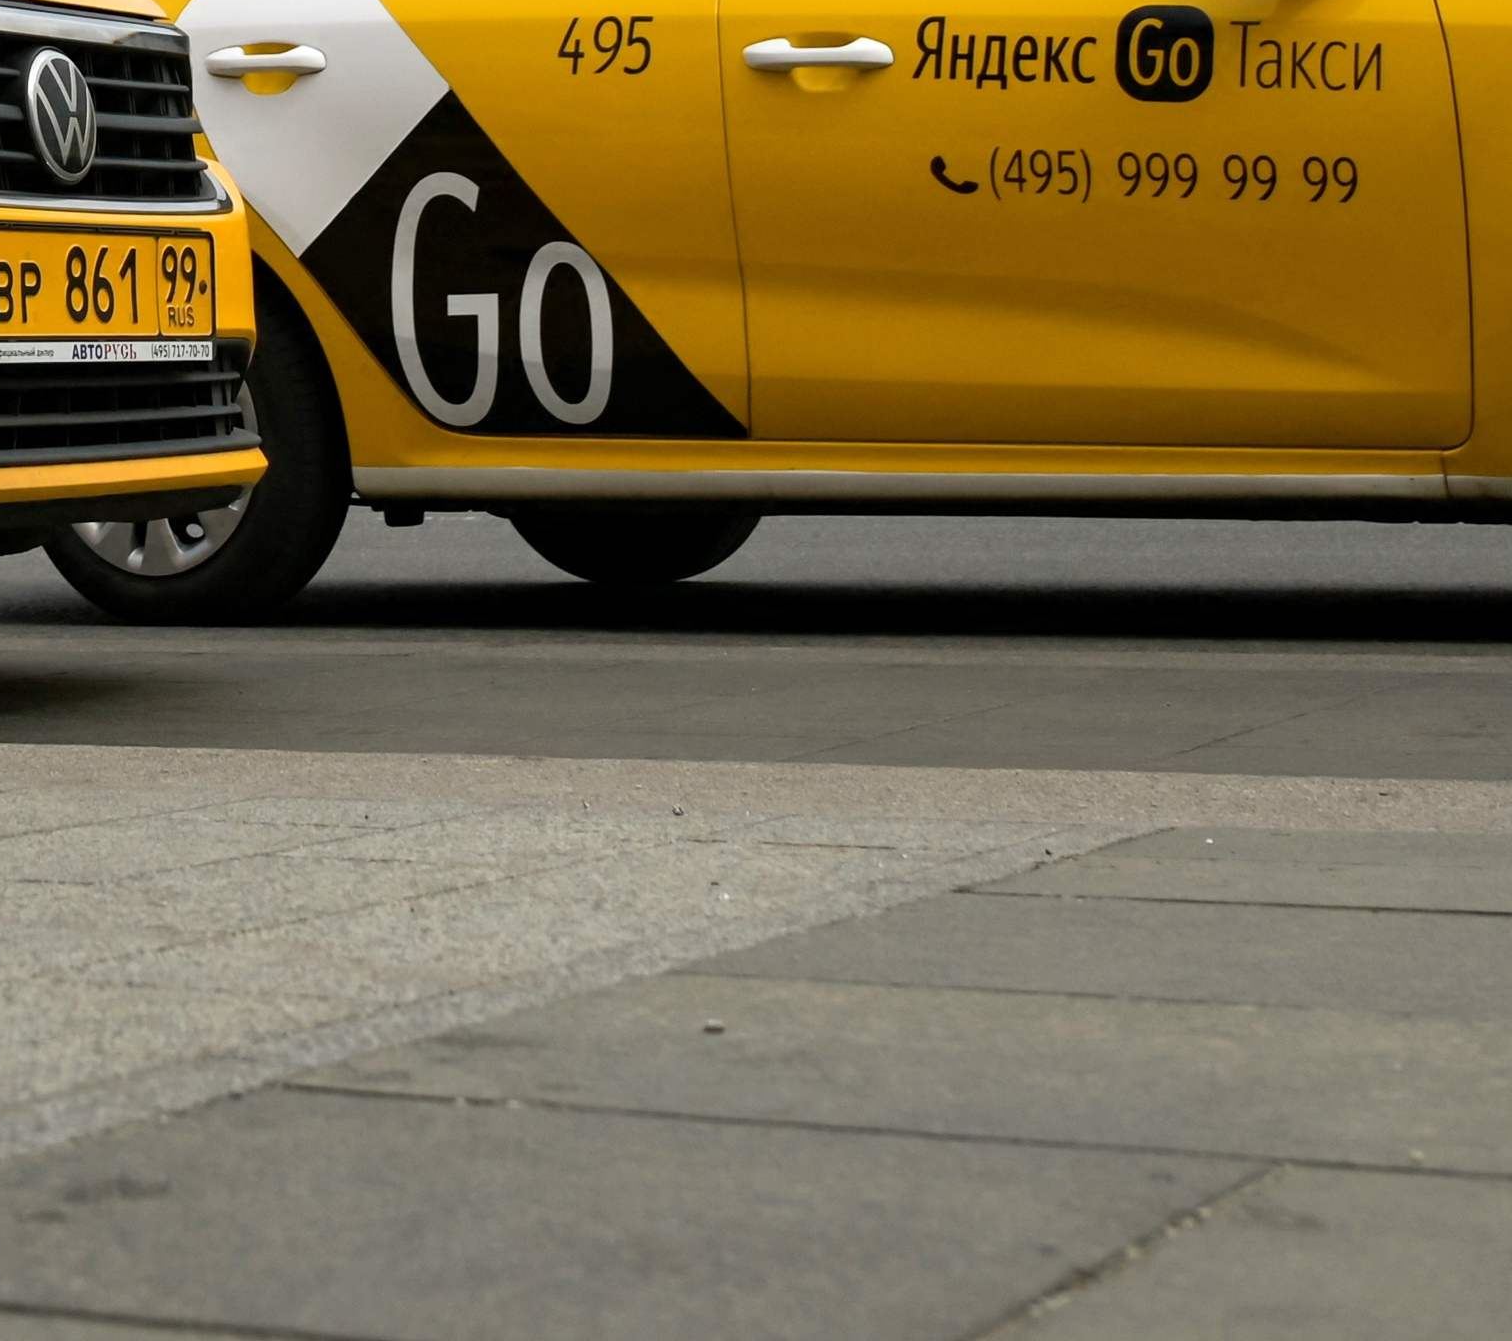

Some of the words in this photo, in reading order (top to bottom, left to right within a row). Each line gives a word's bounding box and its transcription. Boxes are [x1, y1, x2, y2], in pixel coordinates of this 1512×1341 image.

[558, 16, 653, 75] 495
[913, 16, 1097, 90] Яндекс
[1128, 17, 1200, 87] Go
[1229, 19, 1382, 92] Такси
[990, 147, 1092, 204] (495)
[1117, 151, 1199, 199] 999
[1222, 154, 1278, 201] 99
[1302, 156, 1359, 204] 99
[65, 246, 139, 324] 861
[161, 246, 197, 303] 99
[391, 171, 614, 427] Go
[168, 306, 195, 327] RUS
